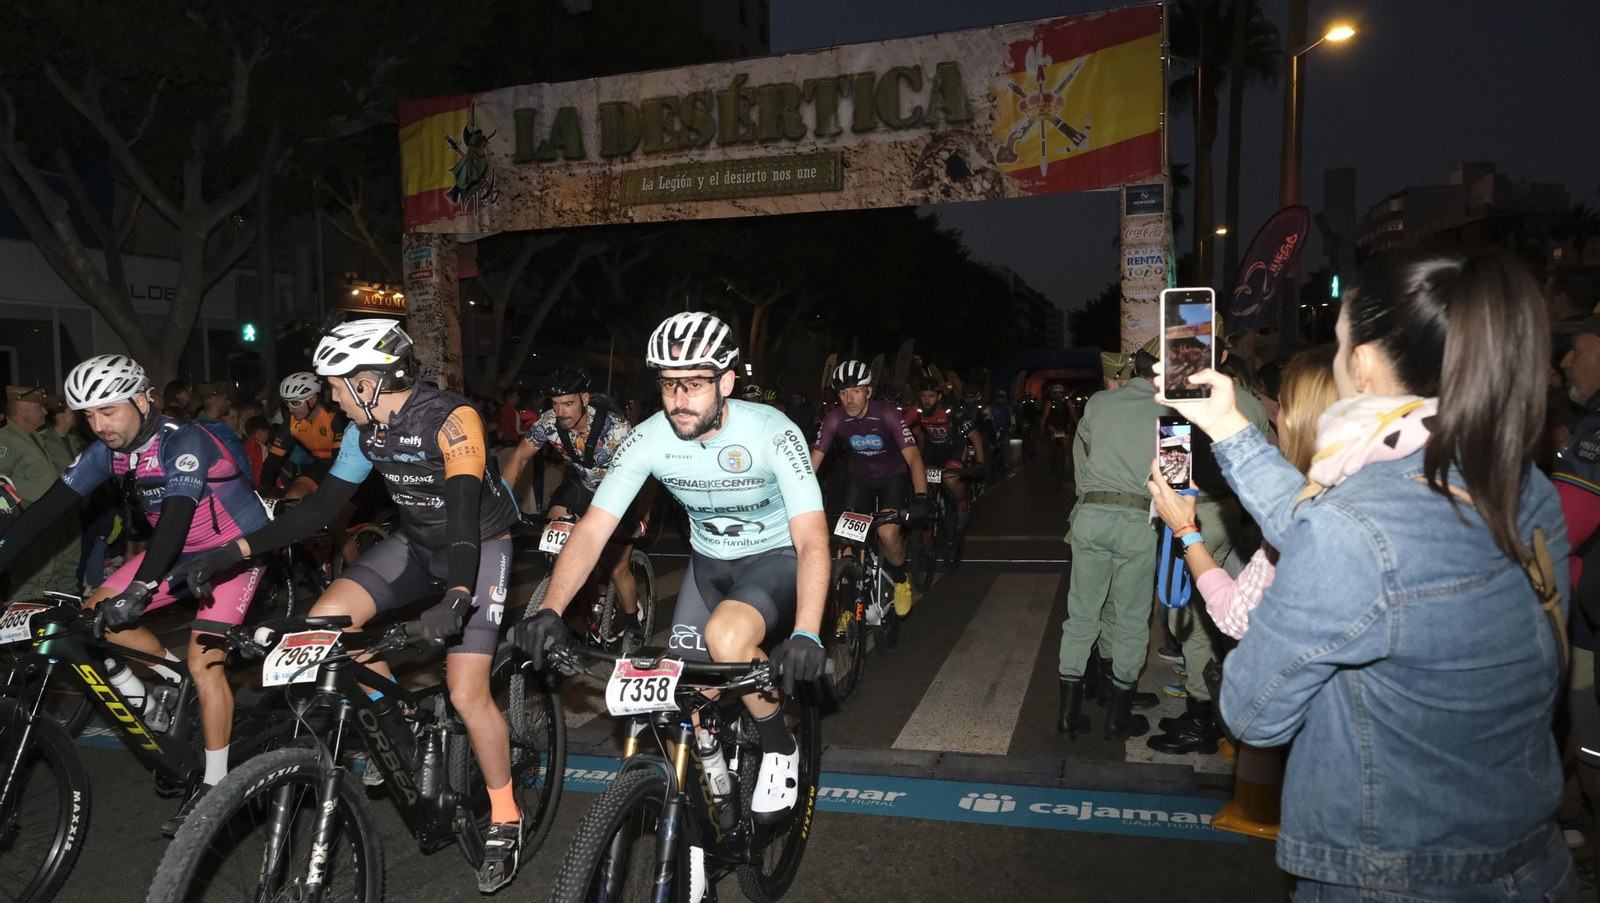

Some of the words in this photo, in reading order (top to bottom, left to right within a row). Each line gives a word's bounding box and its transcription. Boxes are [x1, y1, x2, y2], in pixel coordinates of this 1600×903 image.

[514, 106, 587, 164] LA
[599, 61, 974, 158] DESÉRTICA
[642, 178, 654, 191] La
[659, 174, 692, 192] Legión
[698, 177, 705, 190] y
[709, 174, 720, 186] el
[724, 170, 767, 185] desierto
[772, 169, 792, 182] nos
[797, 167, 817, 180] une
[1127, 256, 1163, 266] RENTA
[399, 436, 422, 447] telfy
[851, 439, 882, 447] KMC
[842, 518, 867, 533] 7560
[668, 634, 707, 651] CCL
[275, 645, 325, 667] 7963
[619, 677, 671, 702] 7358
[71, 662, 165, 755] SCOTT
[357, 708, 419, 807] ORBEA
[64, 790, 82, 851] MAXXIS
[802, 784, 816, 840] MAXXIS
[1122, 820, 1162, 828] CAJA
[306, 842, 330, 887] FOX
